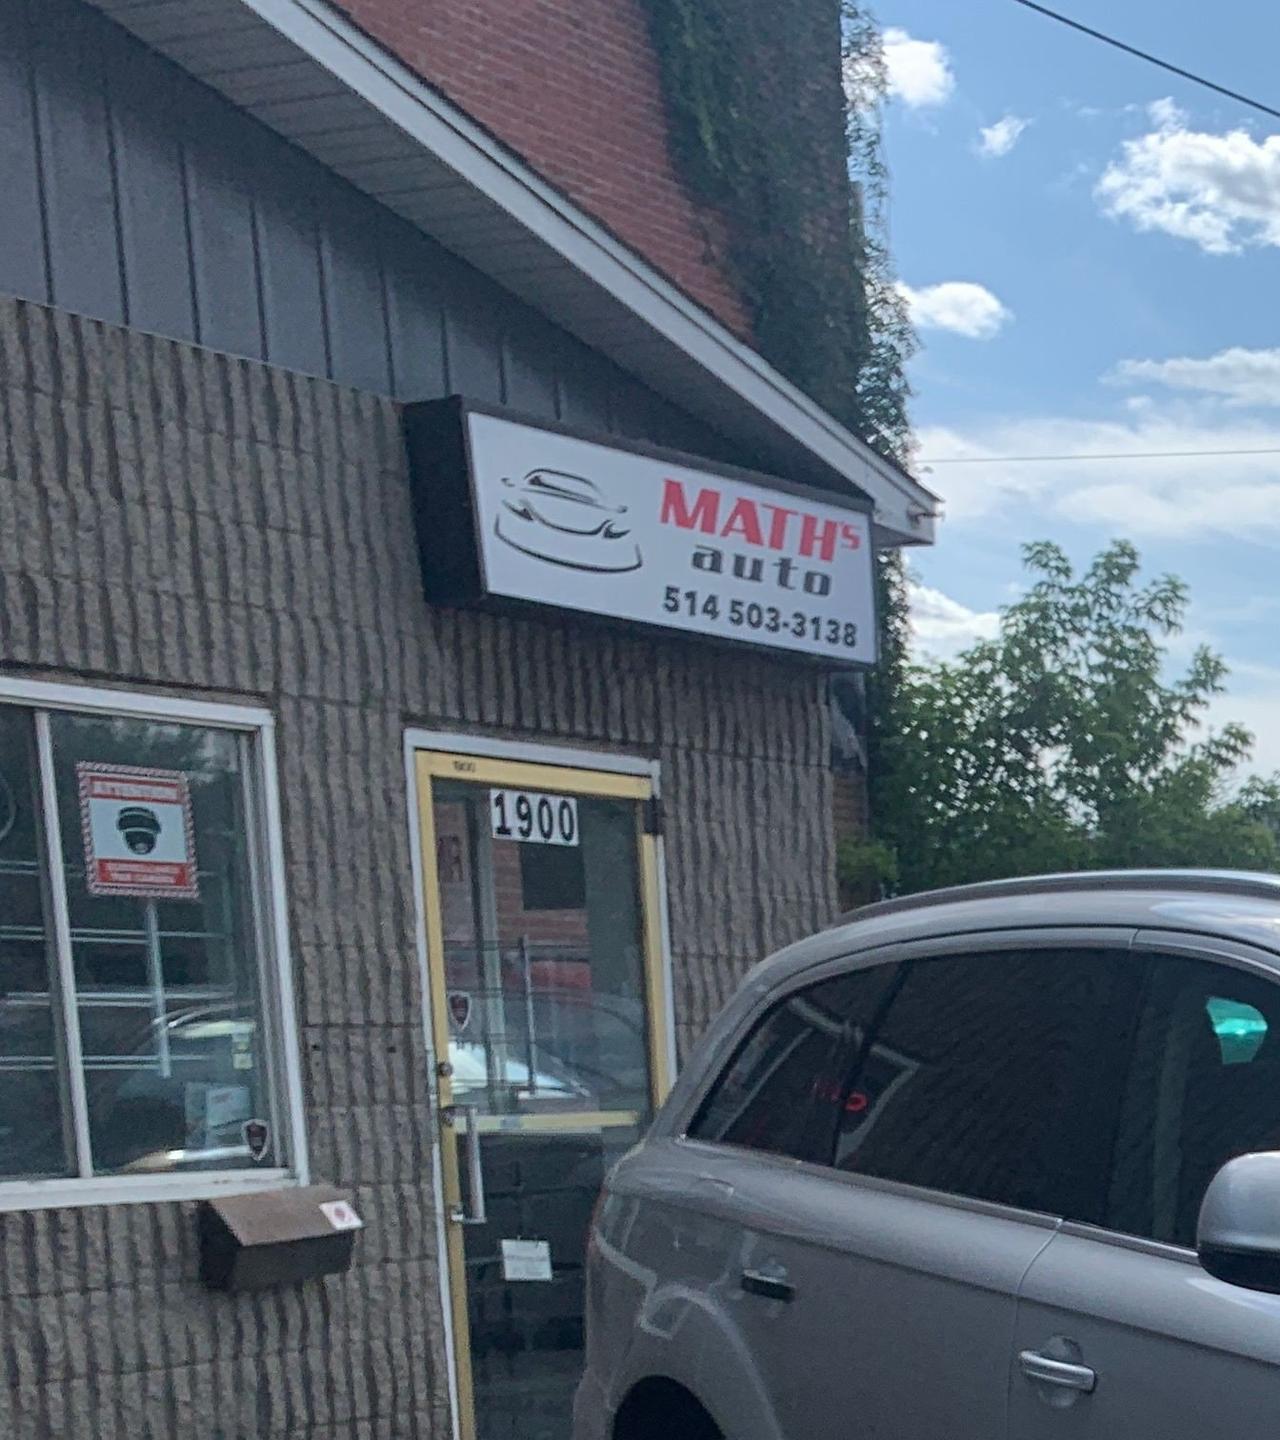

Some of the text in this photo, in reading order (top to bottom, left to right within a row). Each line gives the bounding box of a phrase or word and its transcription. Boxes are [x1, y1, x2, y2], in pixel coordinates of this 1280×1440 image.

[691, 544, 832, 597] auto
[663, 585, 857, 648] 514 503-3138
[494, 793, 576, 842] 1900
